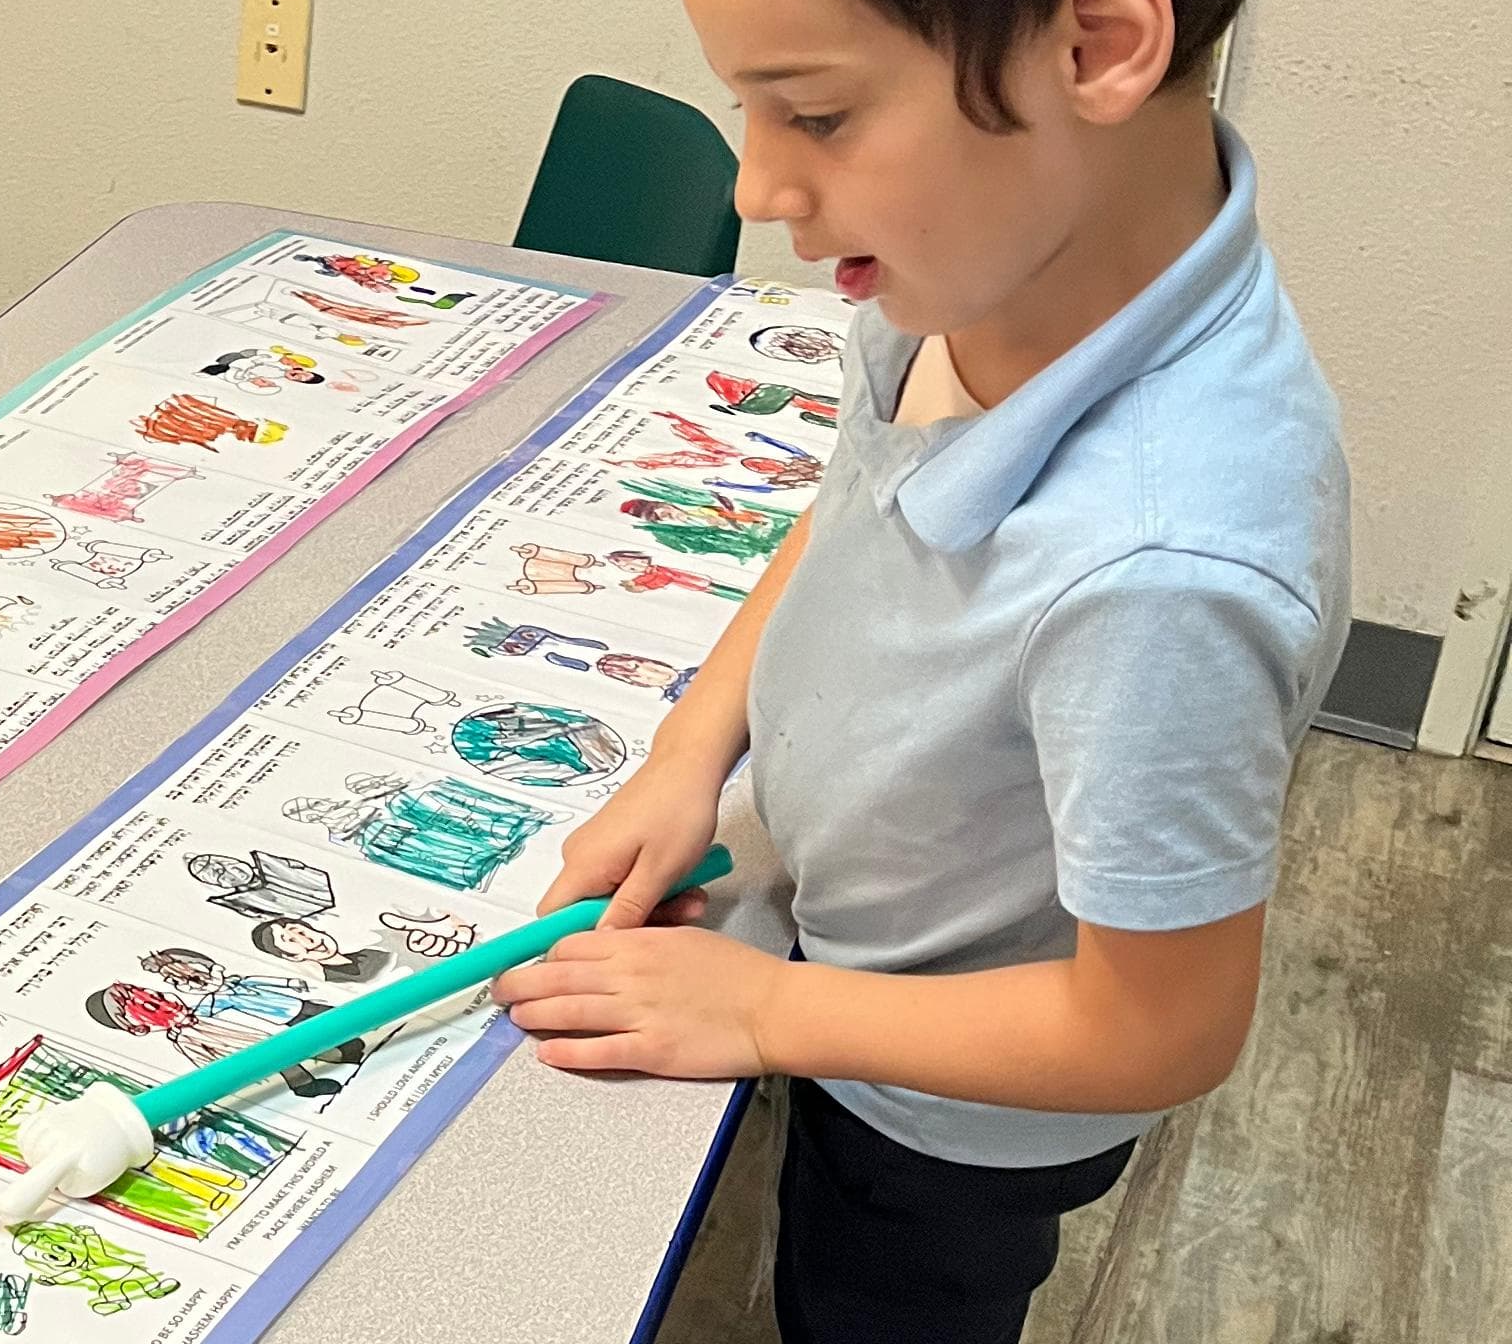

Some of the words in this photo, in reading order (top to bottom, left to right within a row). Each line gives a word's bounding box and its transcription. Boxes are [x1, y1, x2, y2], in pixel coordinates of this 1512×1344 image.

[237, 1216, 262, 1240] HERE
[254, 1207, 270, 1221] TO
[264, 1186, 290, 1212] MAKE
[283, 1170, 304, 1190] THIS
[298, 1145, 328, 1175] WORLD
[261, 1217, 288, 1242] PLACE
[281, 1193, 311, 1221] WHERE
[304, 1162, 338, 1198] HASHEM
[157, 1326, 174, 1340] BE
[167, 1314, 184, 1330] SO
[178, 1286, 208, 1317] HAPPY
